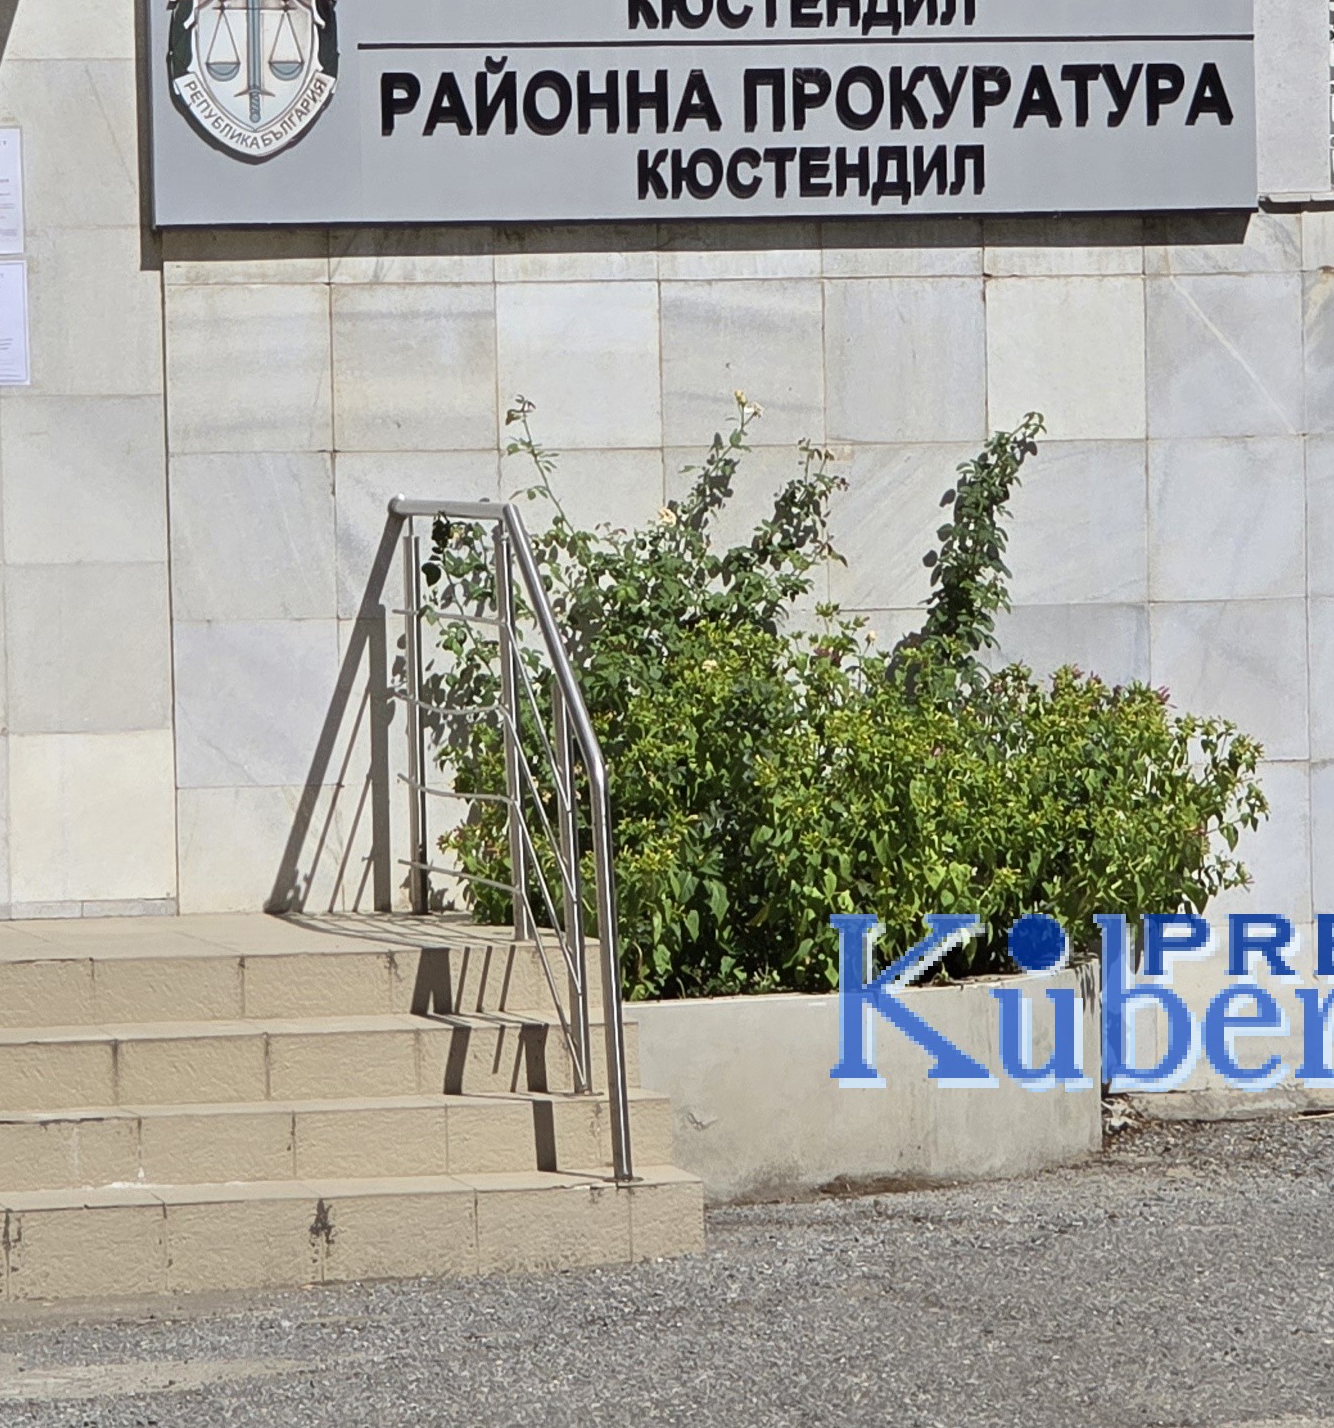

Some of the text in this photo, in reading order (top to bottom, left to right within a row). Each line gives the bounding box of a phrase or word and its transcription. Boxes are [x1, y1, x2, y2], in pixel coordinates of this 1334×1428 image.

[183, 77, 329, 150] РЕПУБЛИКА БЪЛГАРИЯ
[379, 56, 1235, 137] РАЙОННА ПРОКУРАТУРА
[636, 143, 986, 207] КЮСТЕНДИЛ
